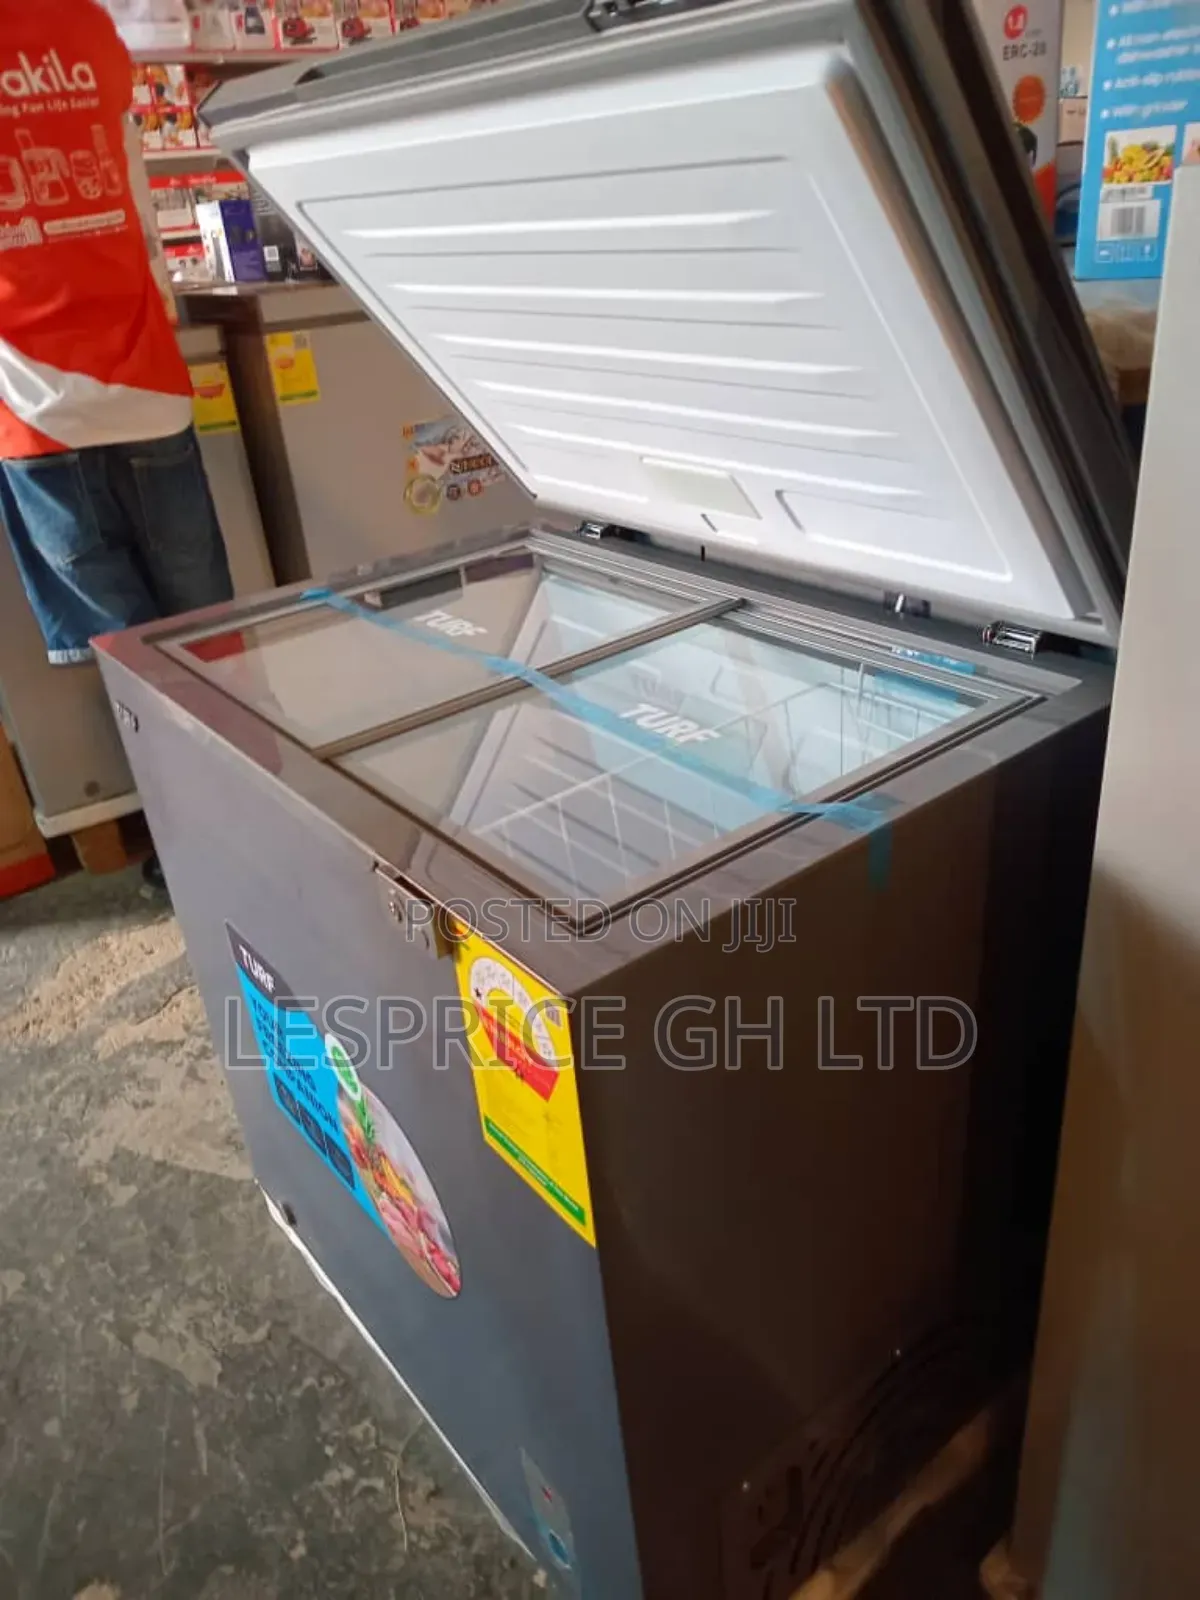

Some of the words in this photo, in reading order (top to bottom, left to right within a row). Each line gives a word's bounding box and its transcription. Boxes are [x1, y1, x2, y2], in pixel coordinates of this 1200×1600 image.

[411, 610, 488, 637] TURF
[617, 703, 723, 747] TURF
[239, 944, 275, 993] TURF
